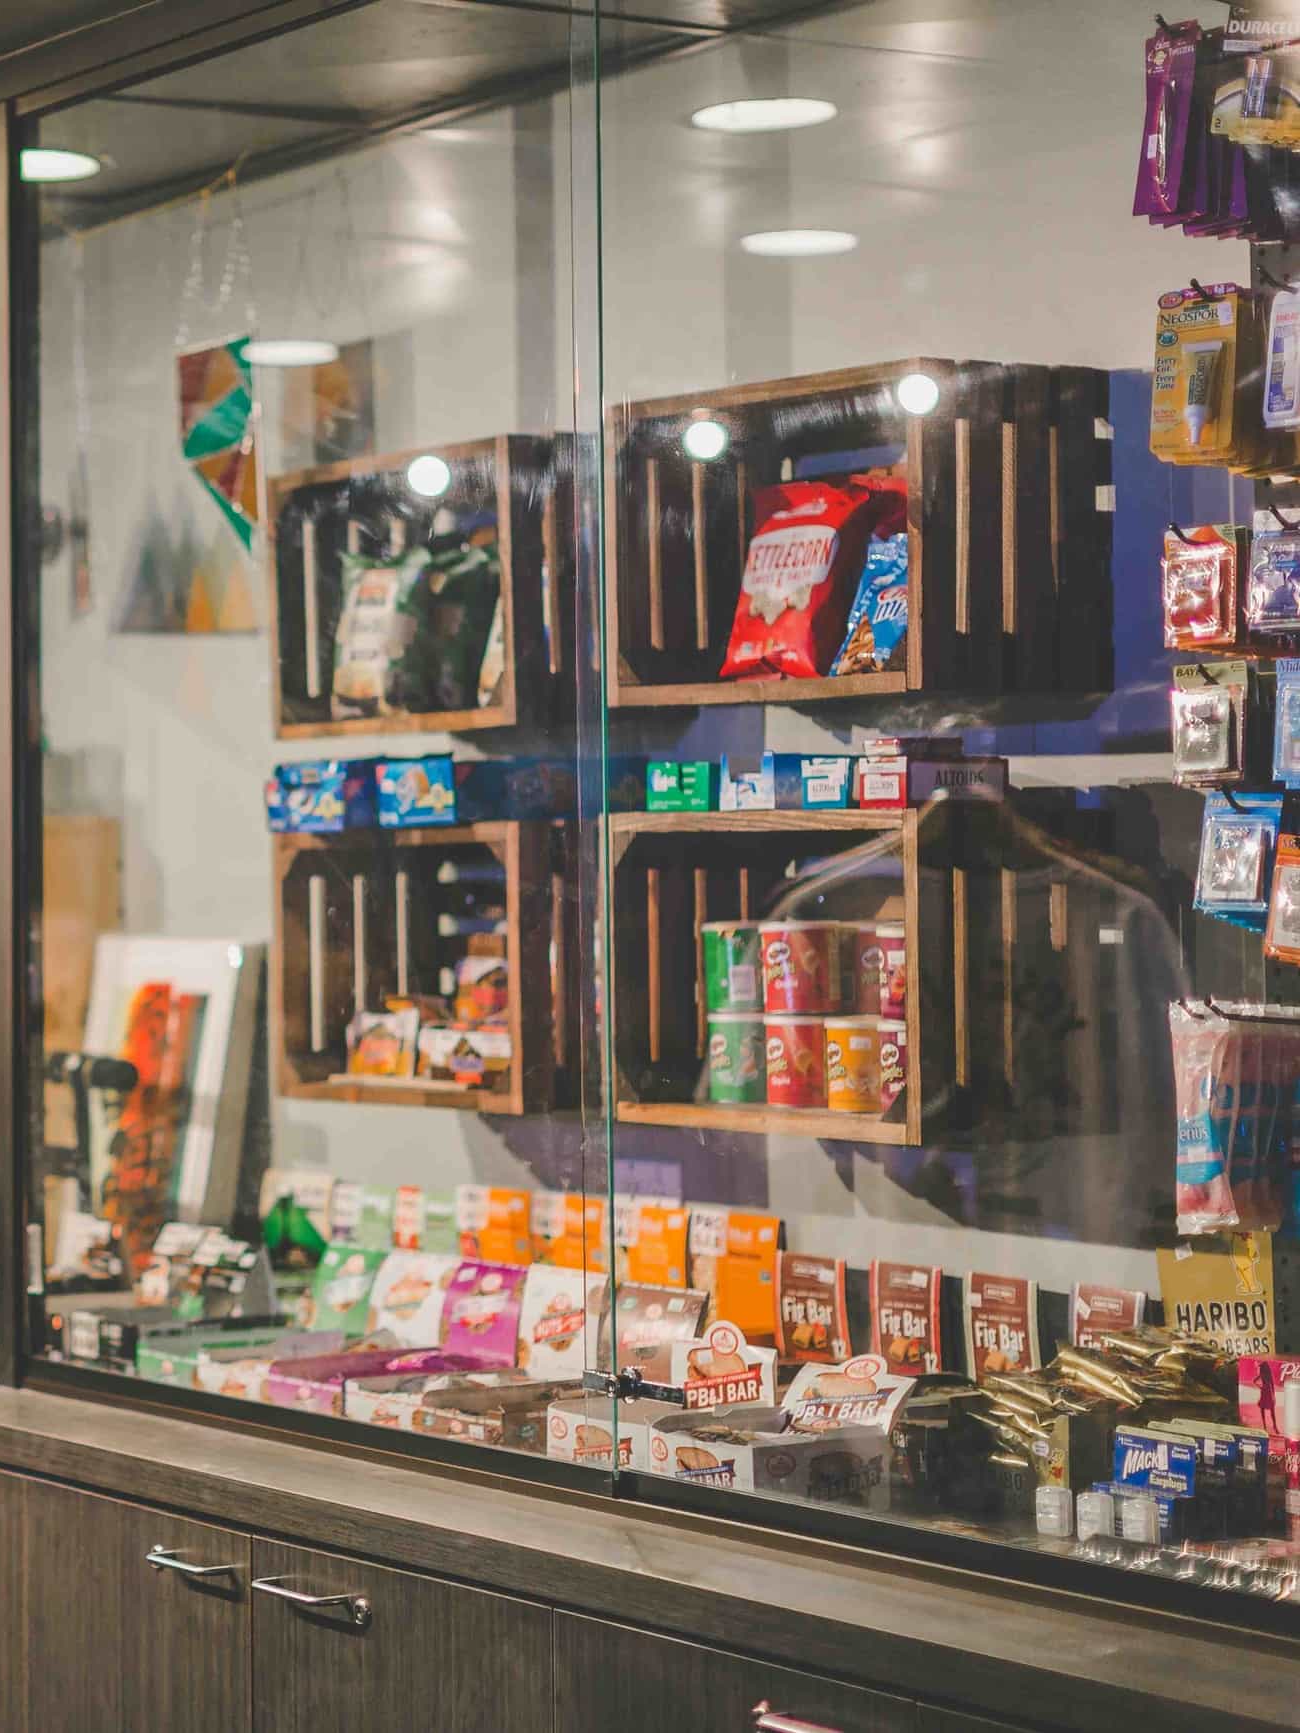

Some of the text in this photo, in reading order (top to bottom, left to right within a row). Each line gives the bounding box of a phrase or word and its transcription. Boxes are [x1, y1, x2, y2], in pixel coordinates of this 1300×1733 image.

[1160, 308, 1219, 326] NEOSPOR
[935, 769, 984, 786] ALTOIDS
[782, 1295, 833, 1326] Fig Bar
[881, 1308, 928, 1338] Fig Bar
[1176, 1300, 1266, 1333] HARIBO
[974, 1321, 1025, 1352] Fig Bar
[686, 1380, 758, 1409] PB&J BAR
[837, 1401, 879, 1419] BAR
